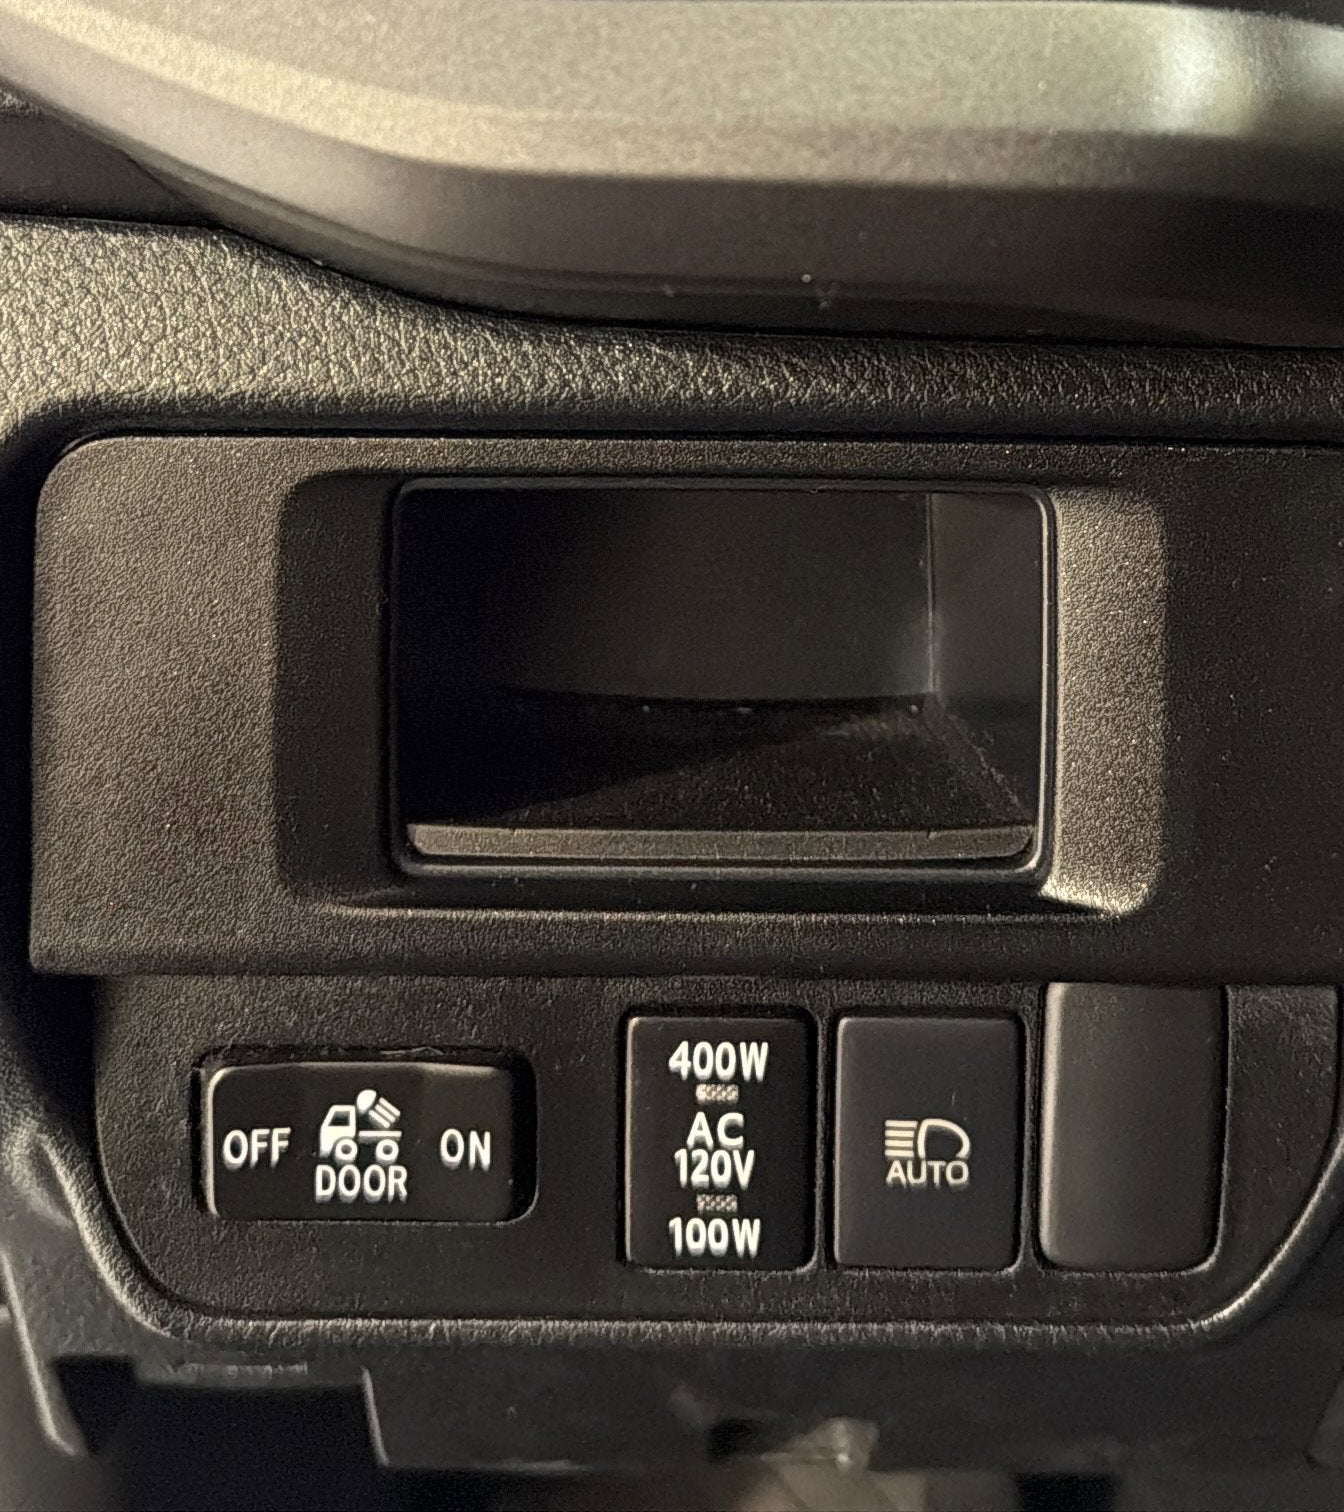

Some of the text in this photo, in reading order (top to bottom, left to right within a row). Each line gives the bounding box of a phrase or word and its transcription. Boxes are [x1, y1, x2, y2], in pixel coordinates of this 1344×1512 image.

[668, 1040, 769, 1082] 400W
[222, 1127, 292, 1169] OFF
[439, 1128, 492, 1171] ON
[686, 1111, 745, 1151] AC
[314, 1164, 408, 1203] DOOR
[673, 1148, 755, 1190] 120V
[885, 1159, 970, 1189] AUTO
[668, 1216, 761, 1258] 100W
